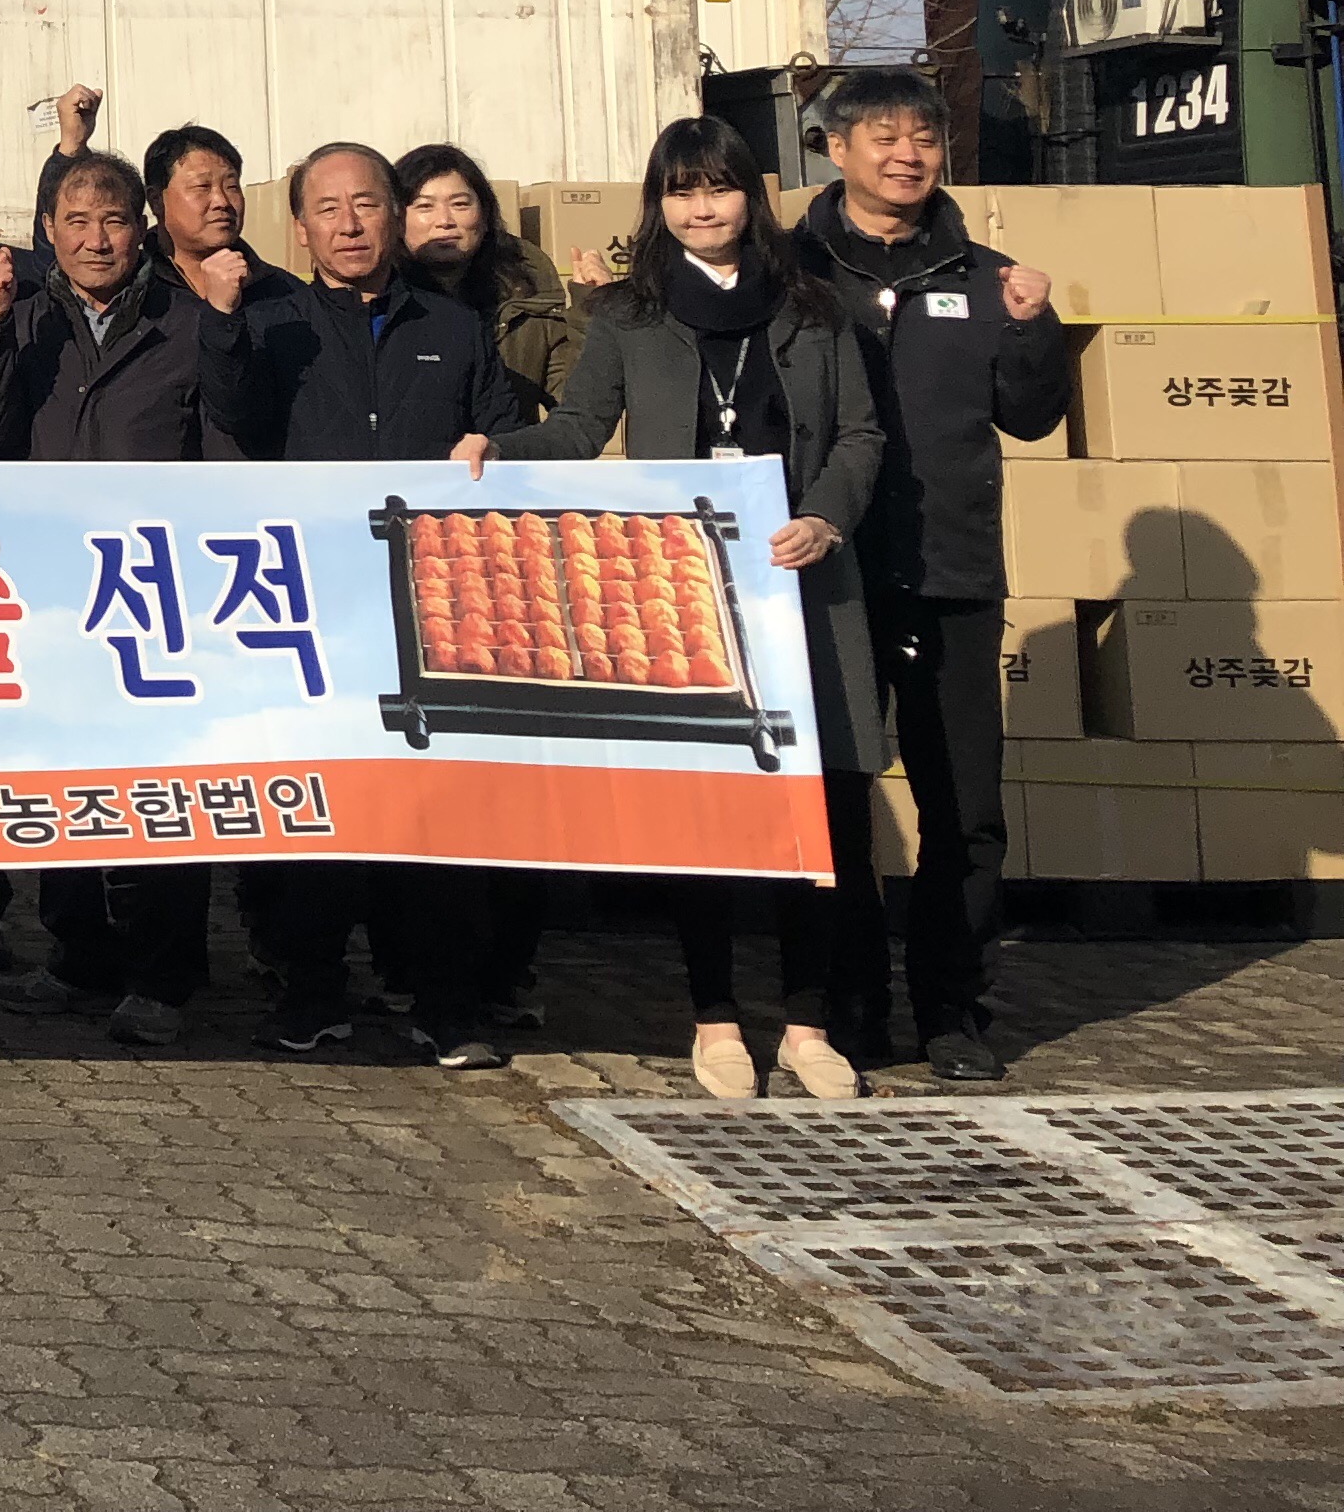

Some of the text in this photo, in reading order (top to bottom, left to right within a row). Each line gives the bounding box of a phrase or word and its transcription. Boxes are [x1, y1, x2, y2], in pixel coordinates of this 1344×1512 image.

[1130, 64, 1229, 138] 1234
[1163, 377, 1291, 407] 상주곶감
[85, 525, 325, 698] 선적
[1184, 657, 1313, 689] 상주곶감
